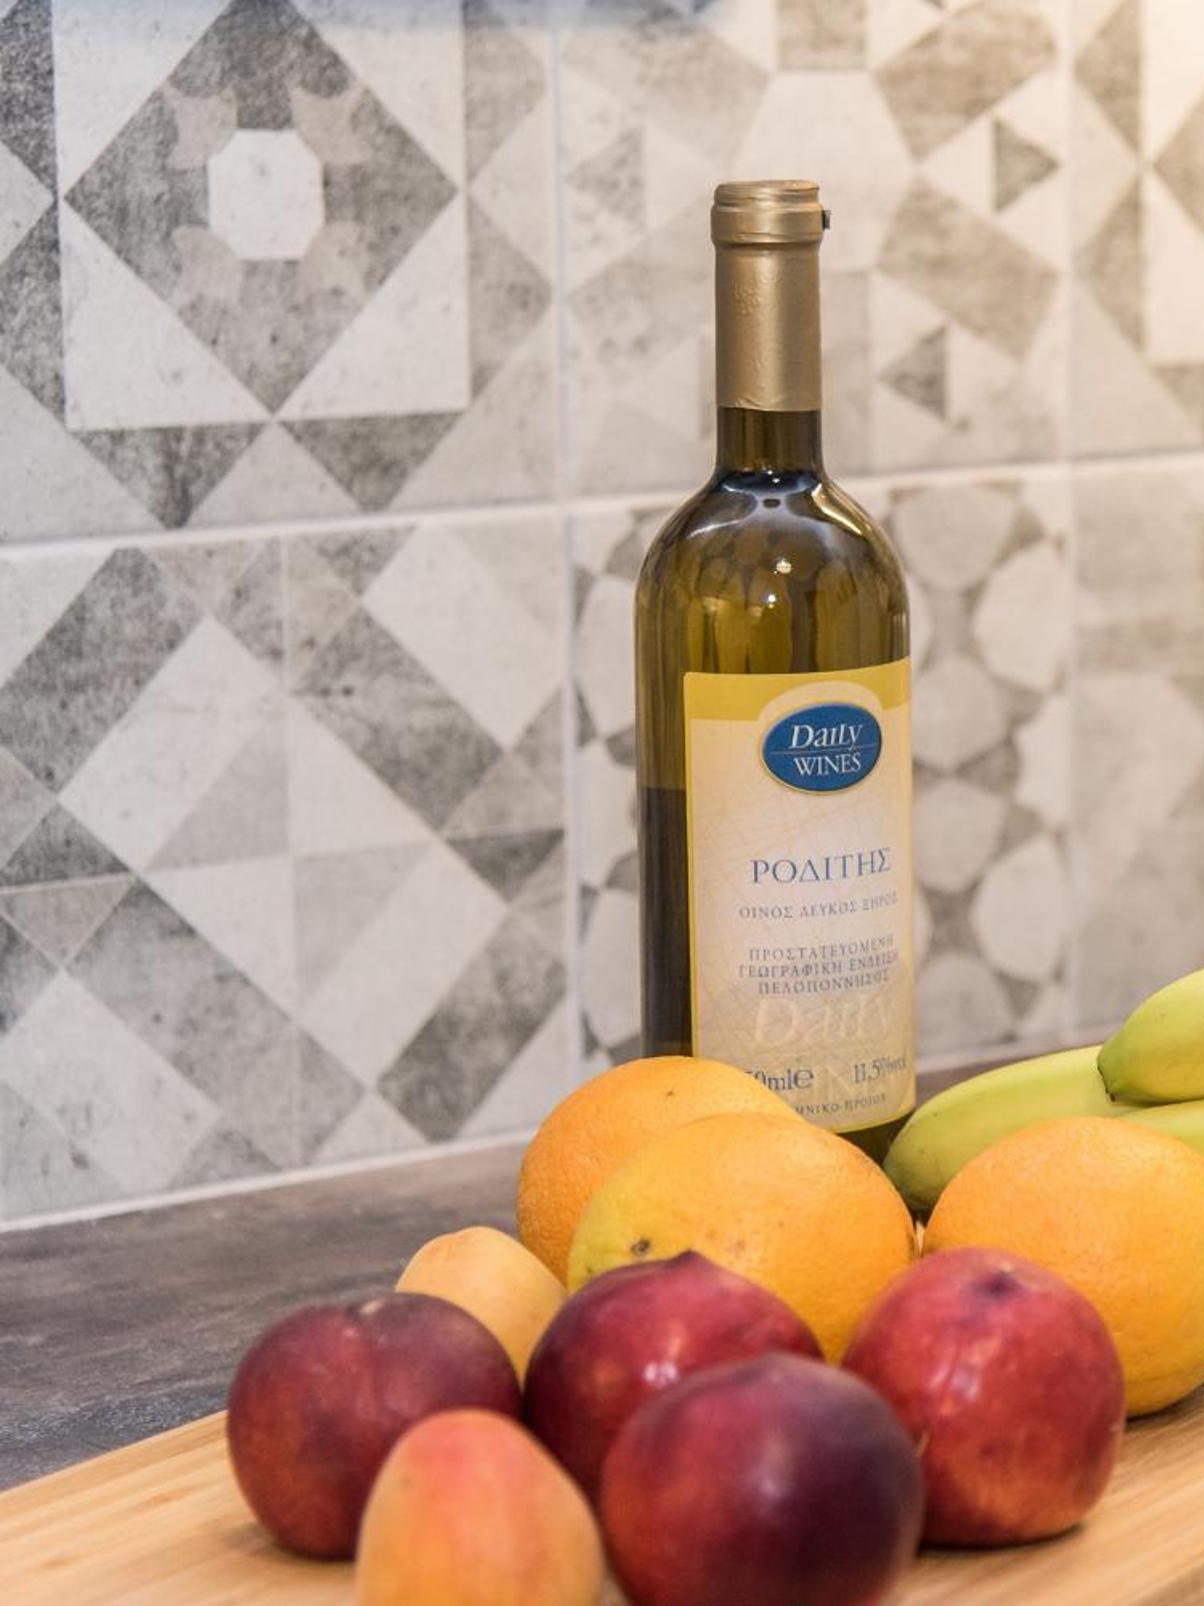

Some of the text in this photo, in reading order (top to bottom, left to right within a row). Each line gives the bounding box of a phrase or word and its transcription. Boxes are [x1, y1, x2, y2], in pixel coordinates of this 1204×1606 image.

[788, 723, 864, 750] Daily
[794, 752, 862, 776] WINES
[750, 847, 891, 884] ΡΟΔΙΤΗΣ
[738, 905, 794, 919] ΟΙΝΟΣ
